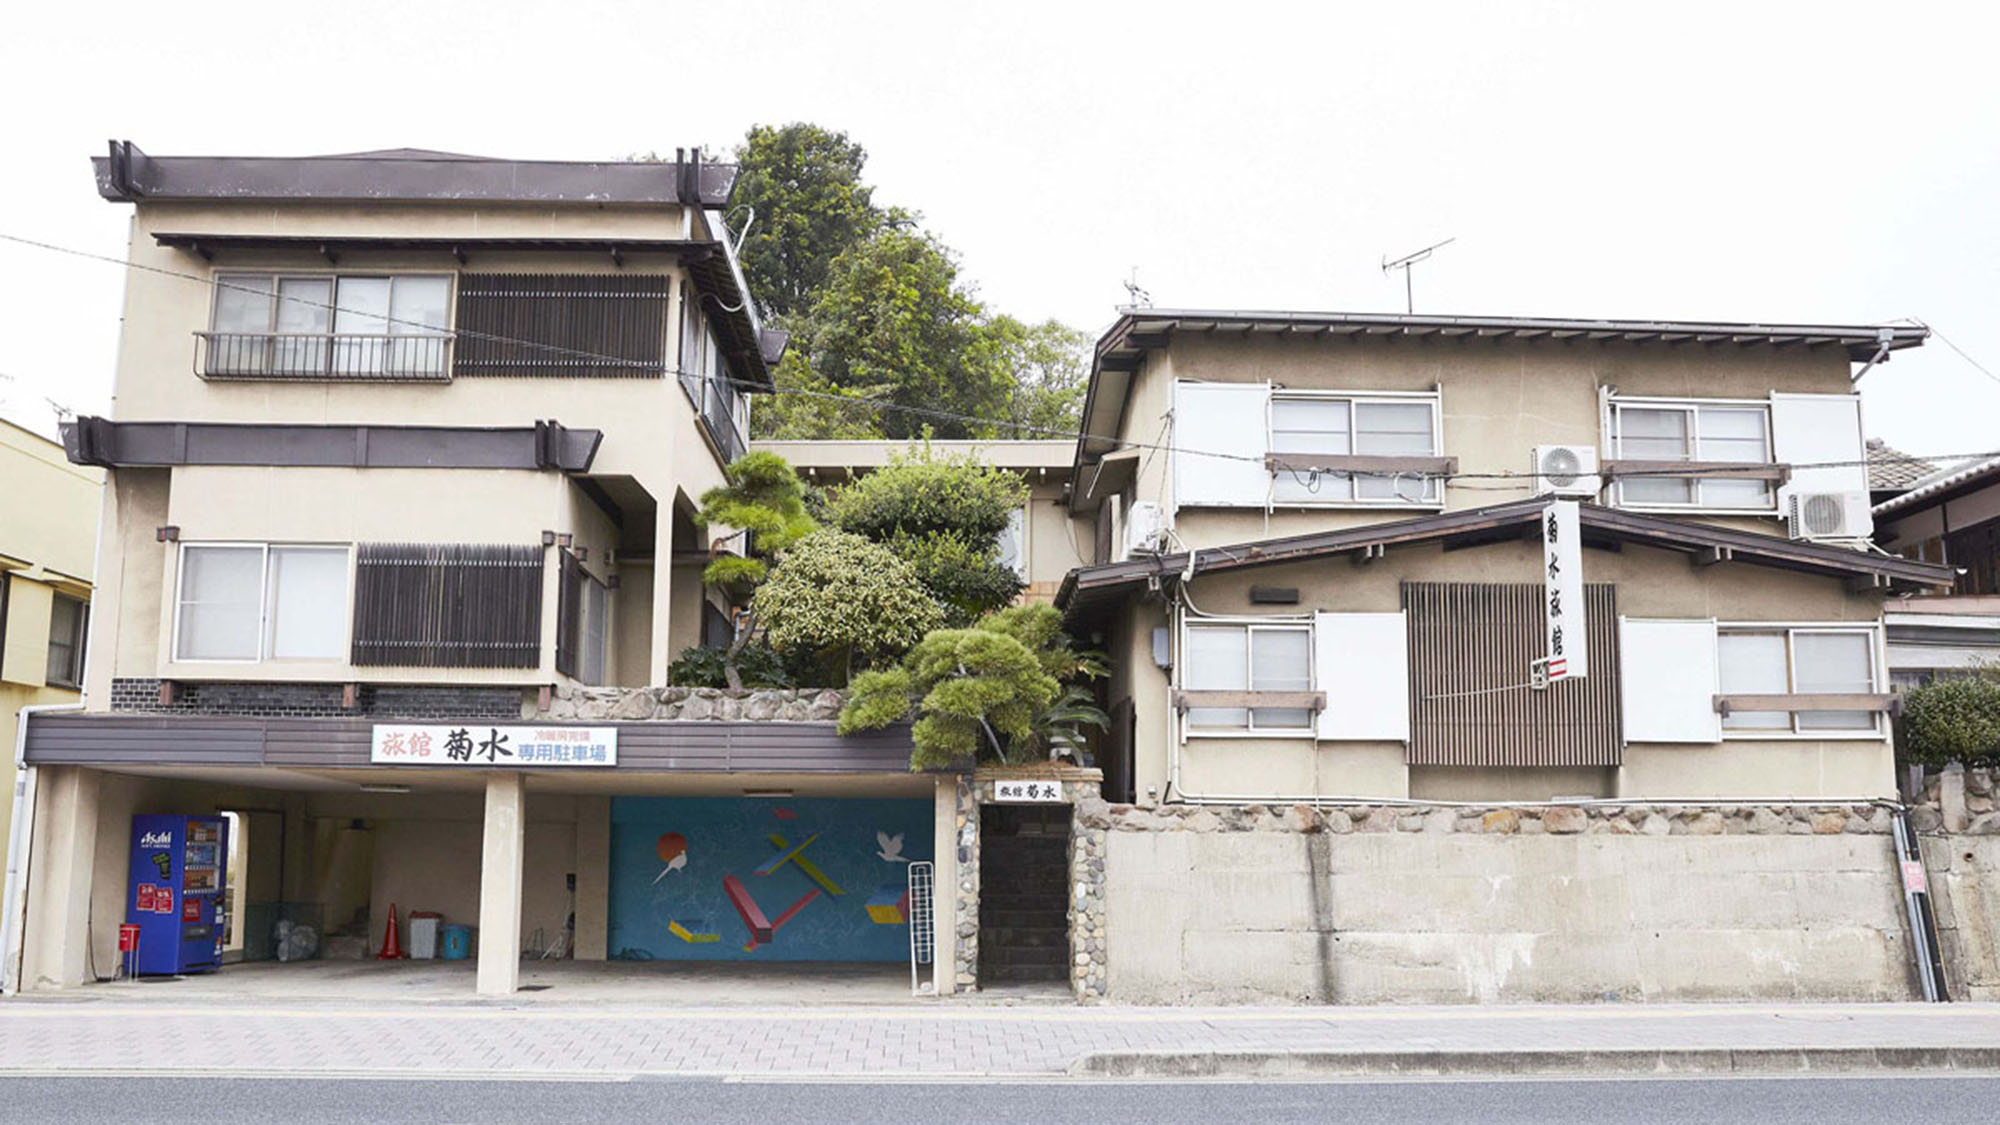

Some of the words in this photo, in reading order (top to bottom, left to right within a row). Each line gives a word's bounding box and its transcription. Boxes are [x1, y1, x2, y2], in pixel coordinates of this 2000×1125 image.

[382, 731, 433, 757] 旅館
[443, 727, 514, 762] 菊水
[140, 831, 172, 844] Asahi
